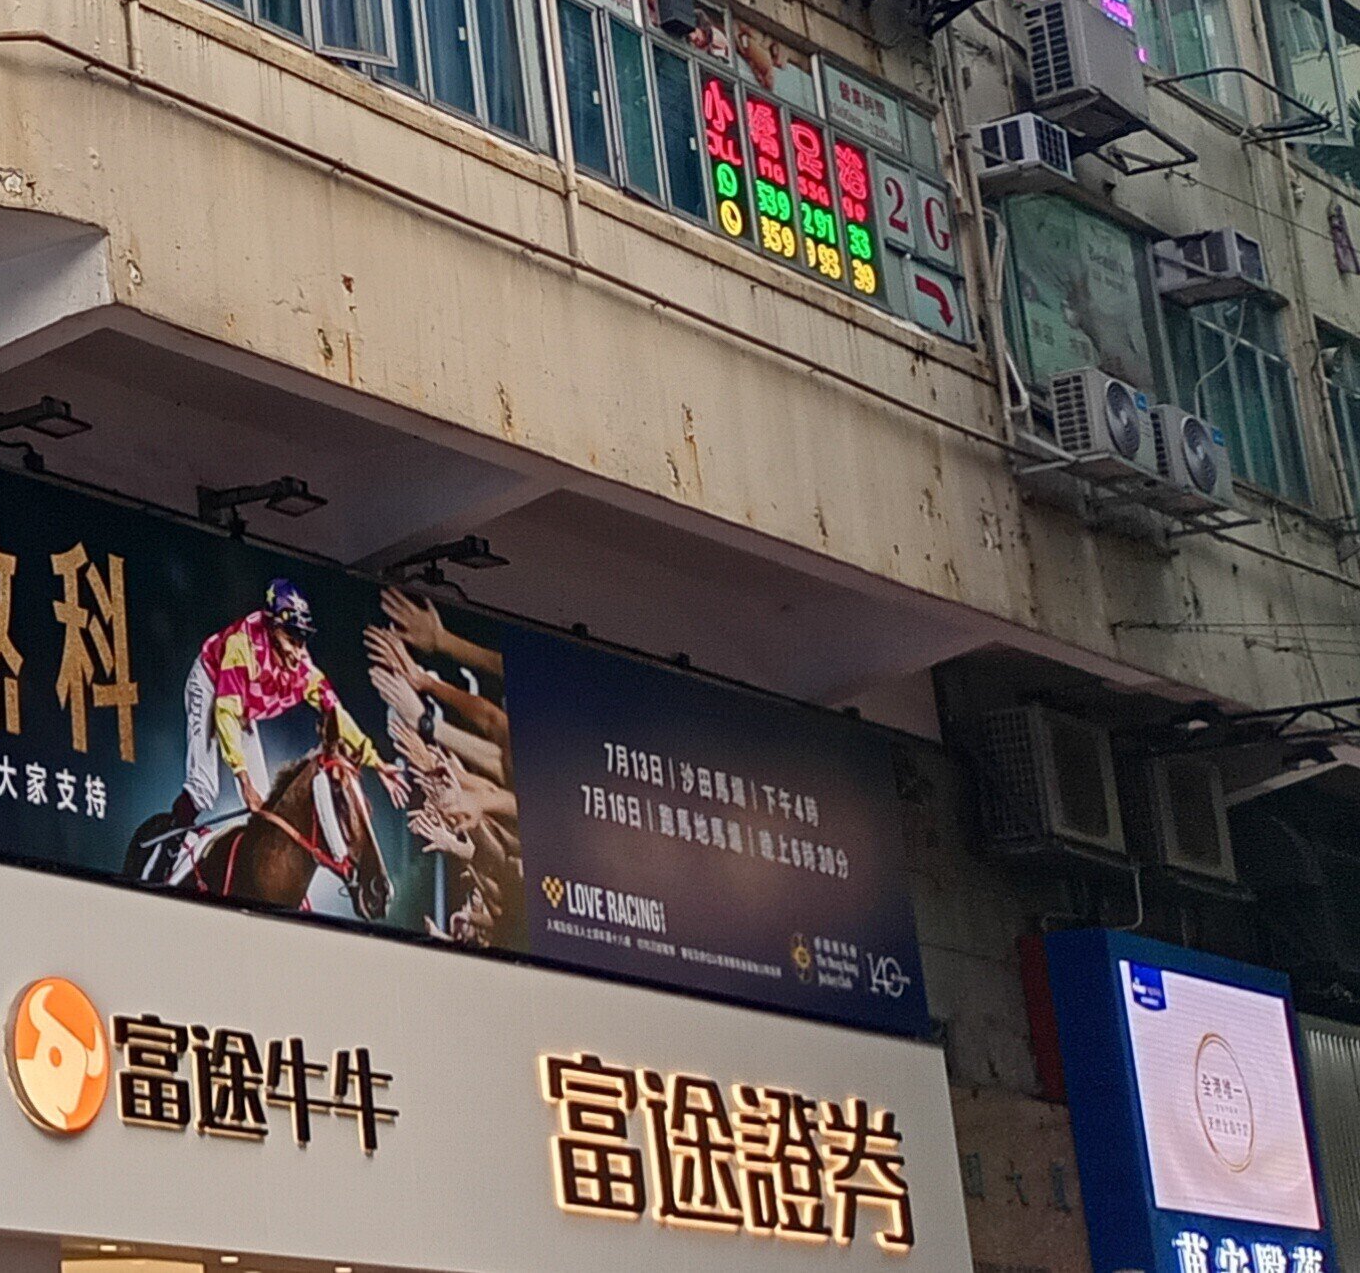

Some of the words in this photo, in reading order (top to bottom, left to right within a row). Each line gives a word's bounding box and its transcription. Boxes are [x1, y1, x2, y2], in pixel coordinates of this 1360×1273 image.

[581, 785, 642, 829] 7月16日
[604, 742, 664, 788] 7月13日
[762, 784, 819, 827] 下午4時
[566, 880, 605, 921] LOVE
[113, 1012, 400, 1154] 富途牛牛
[541, 1050, 918, 1252] 富途證券
